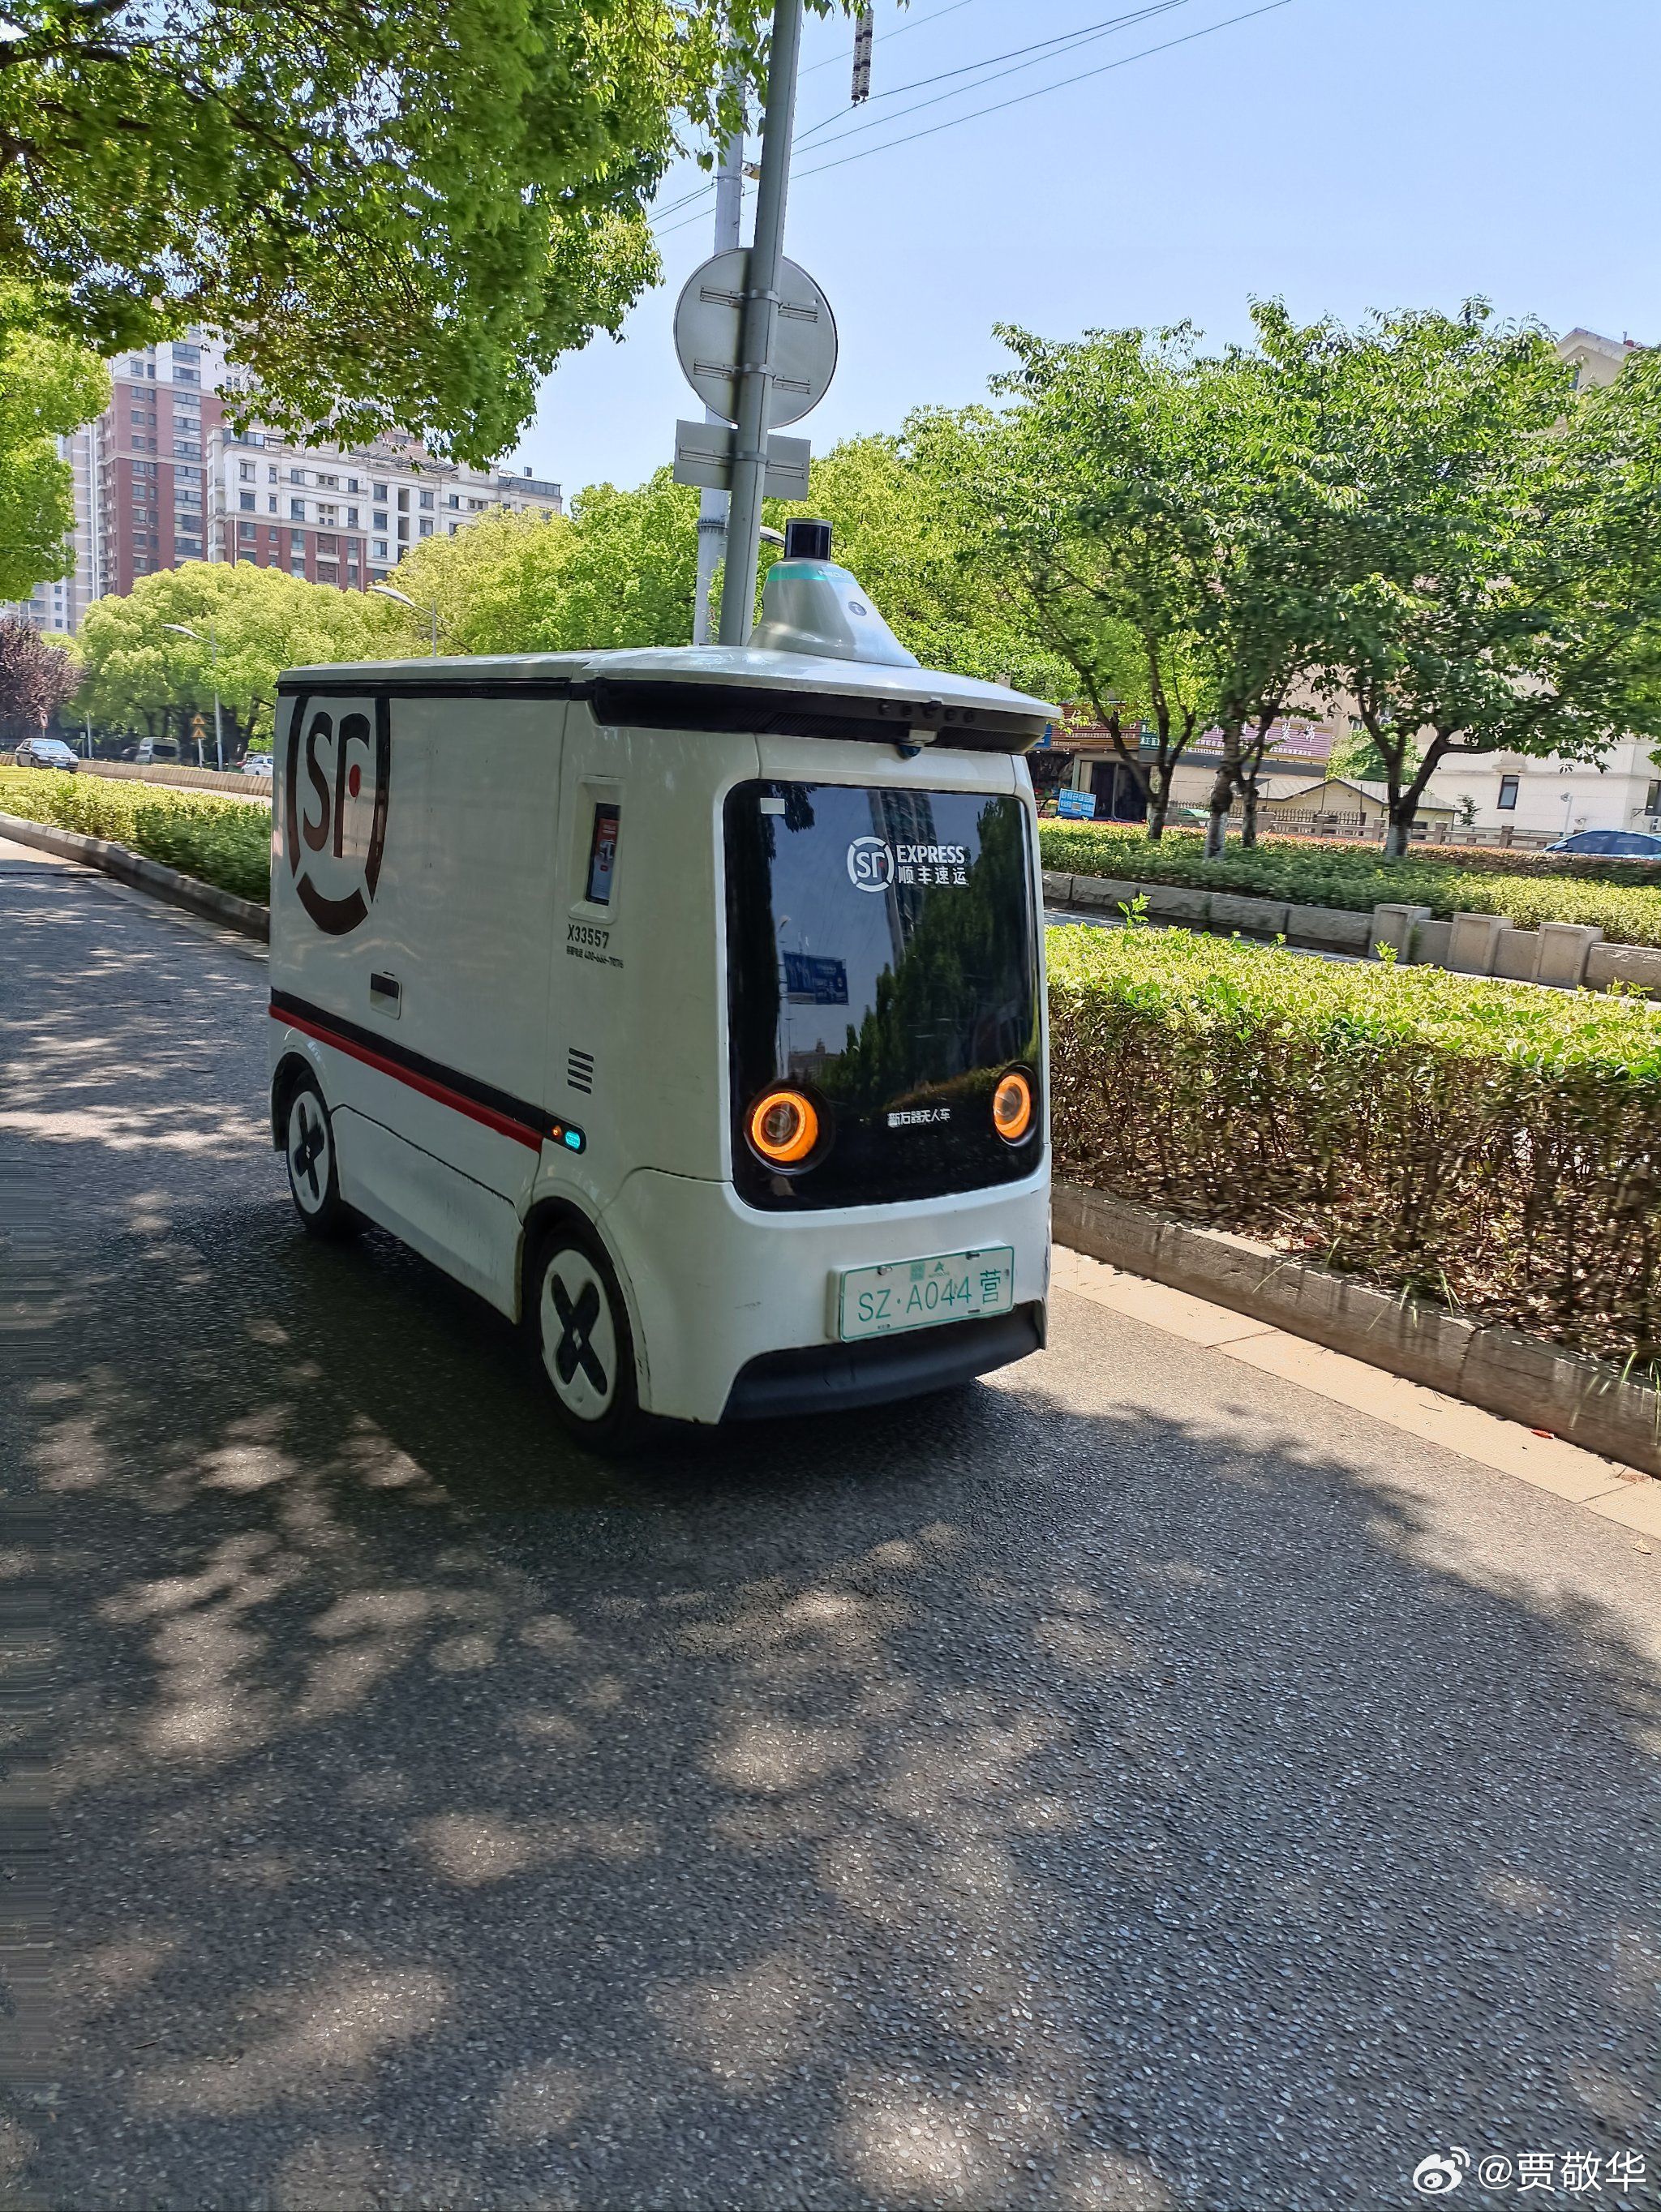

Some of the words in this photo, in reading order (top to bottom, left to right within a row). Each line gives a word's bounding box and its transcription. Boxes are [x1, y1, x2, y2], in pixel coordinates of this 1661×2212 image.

[896, 844, 965, 864] EXPRESS
[898, 865, 968, 885] 顺丰速运
[567, 924, 610, 949] X33557
